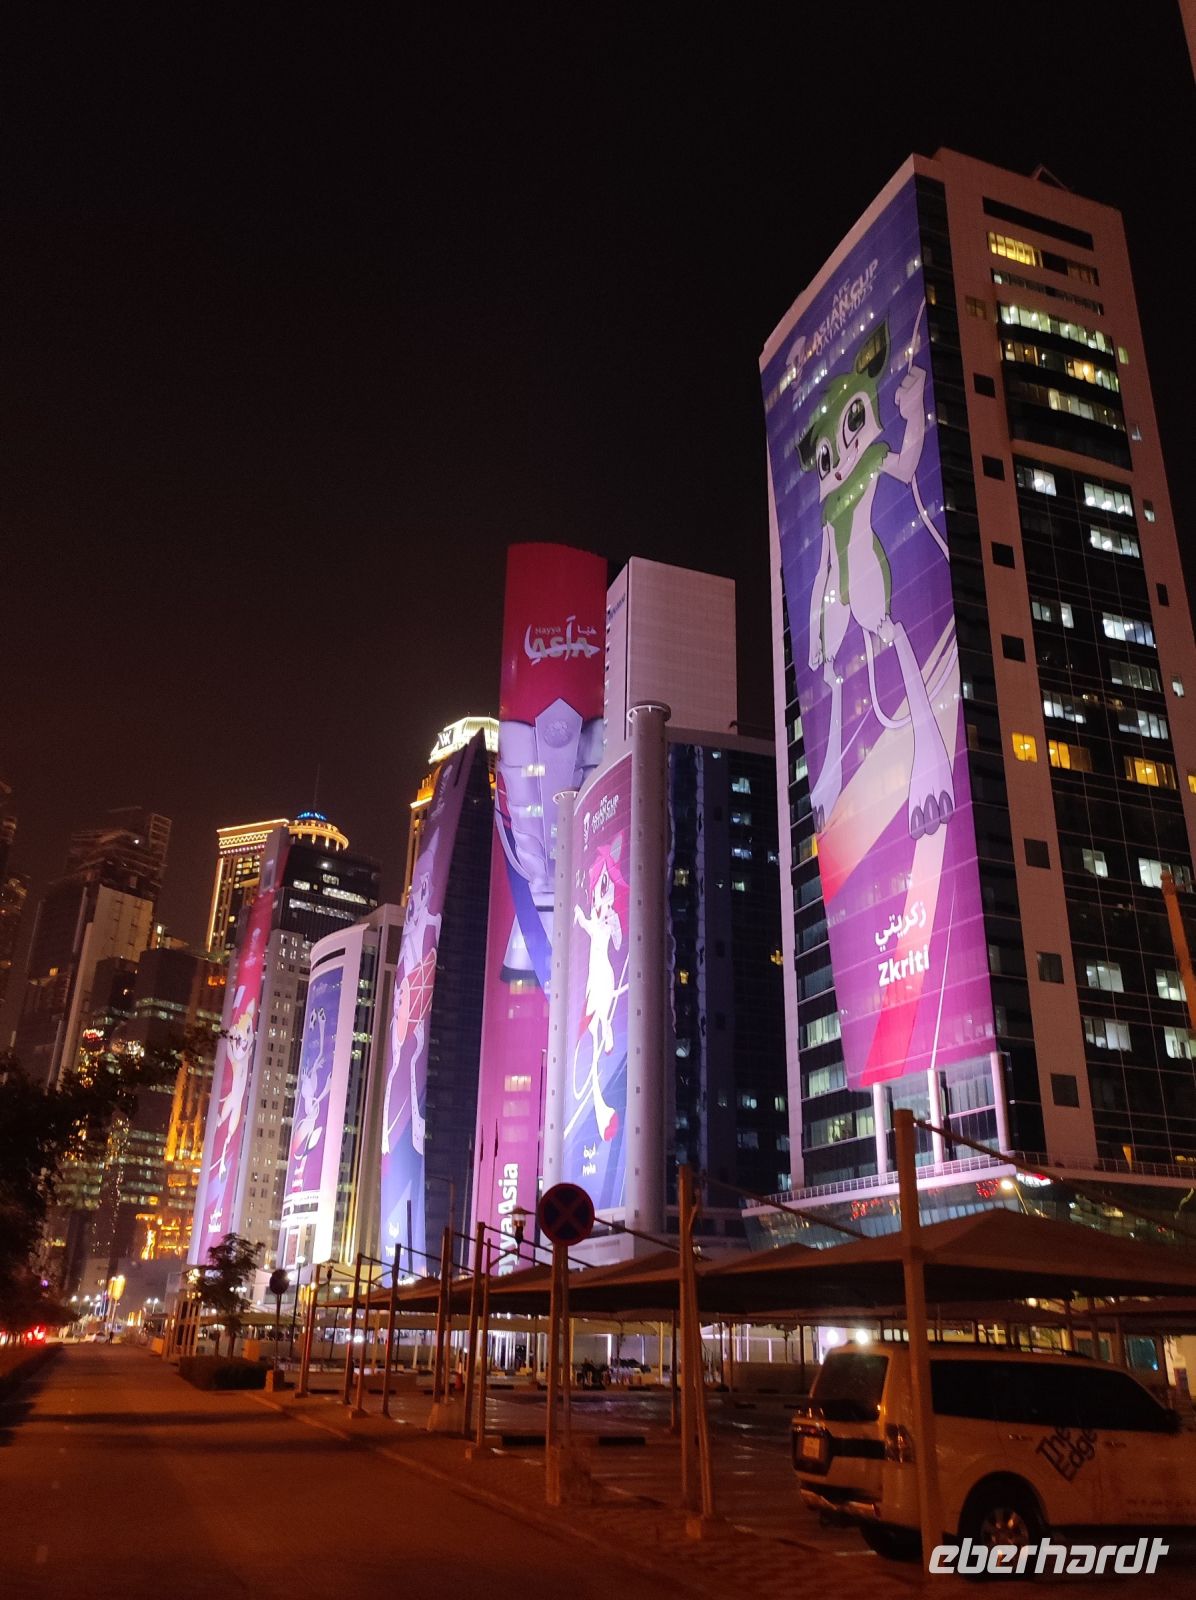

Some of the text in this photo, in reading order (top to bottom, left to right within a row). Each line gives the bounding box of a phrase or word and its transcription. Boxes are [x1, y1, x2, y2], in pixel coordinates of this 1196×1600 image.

[875, 901, 927, 952] زكريتي
[877, 944, 930, 987] Zkriti
[1036, 1425, 1072, 1466] The
[1055, 1427, 1098, 1482] Edge
